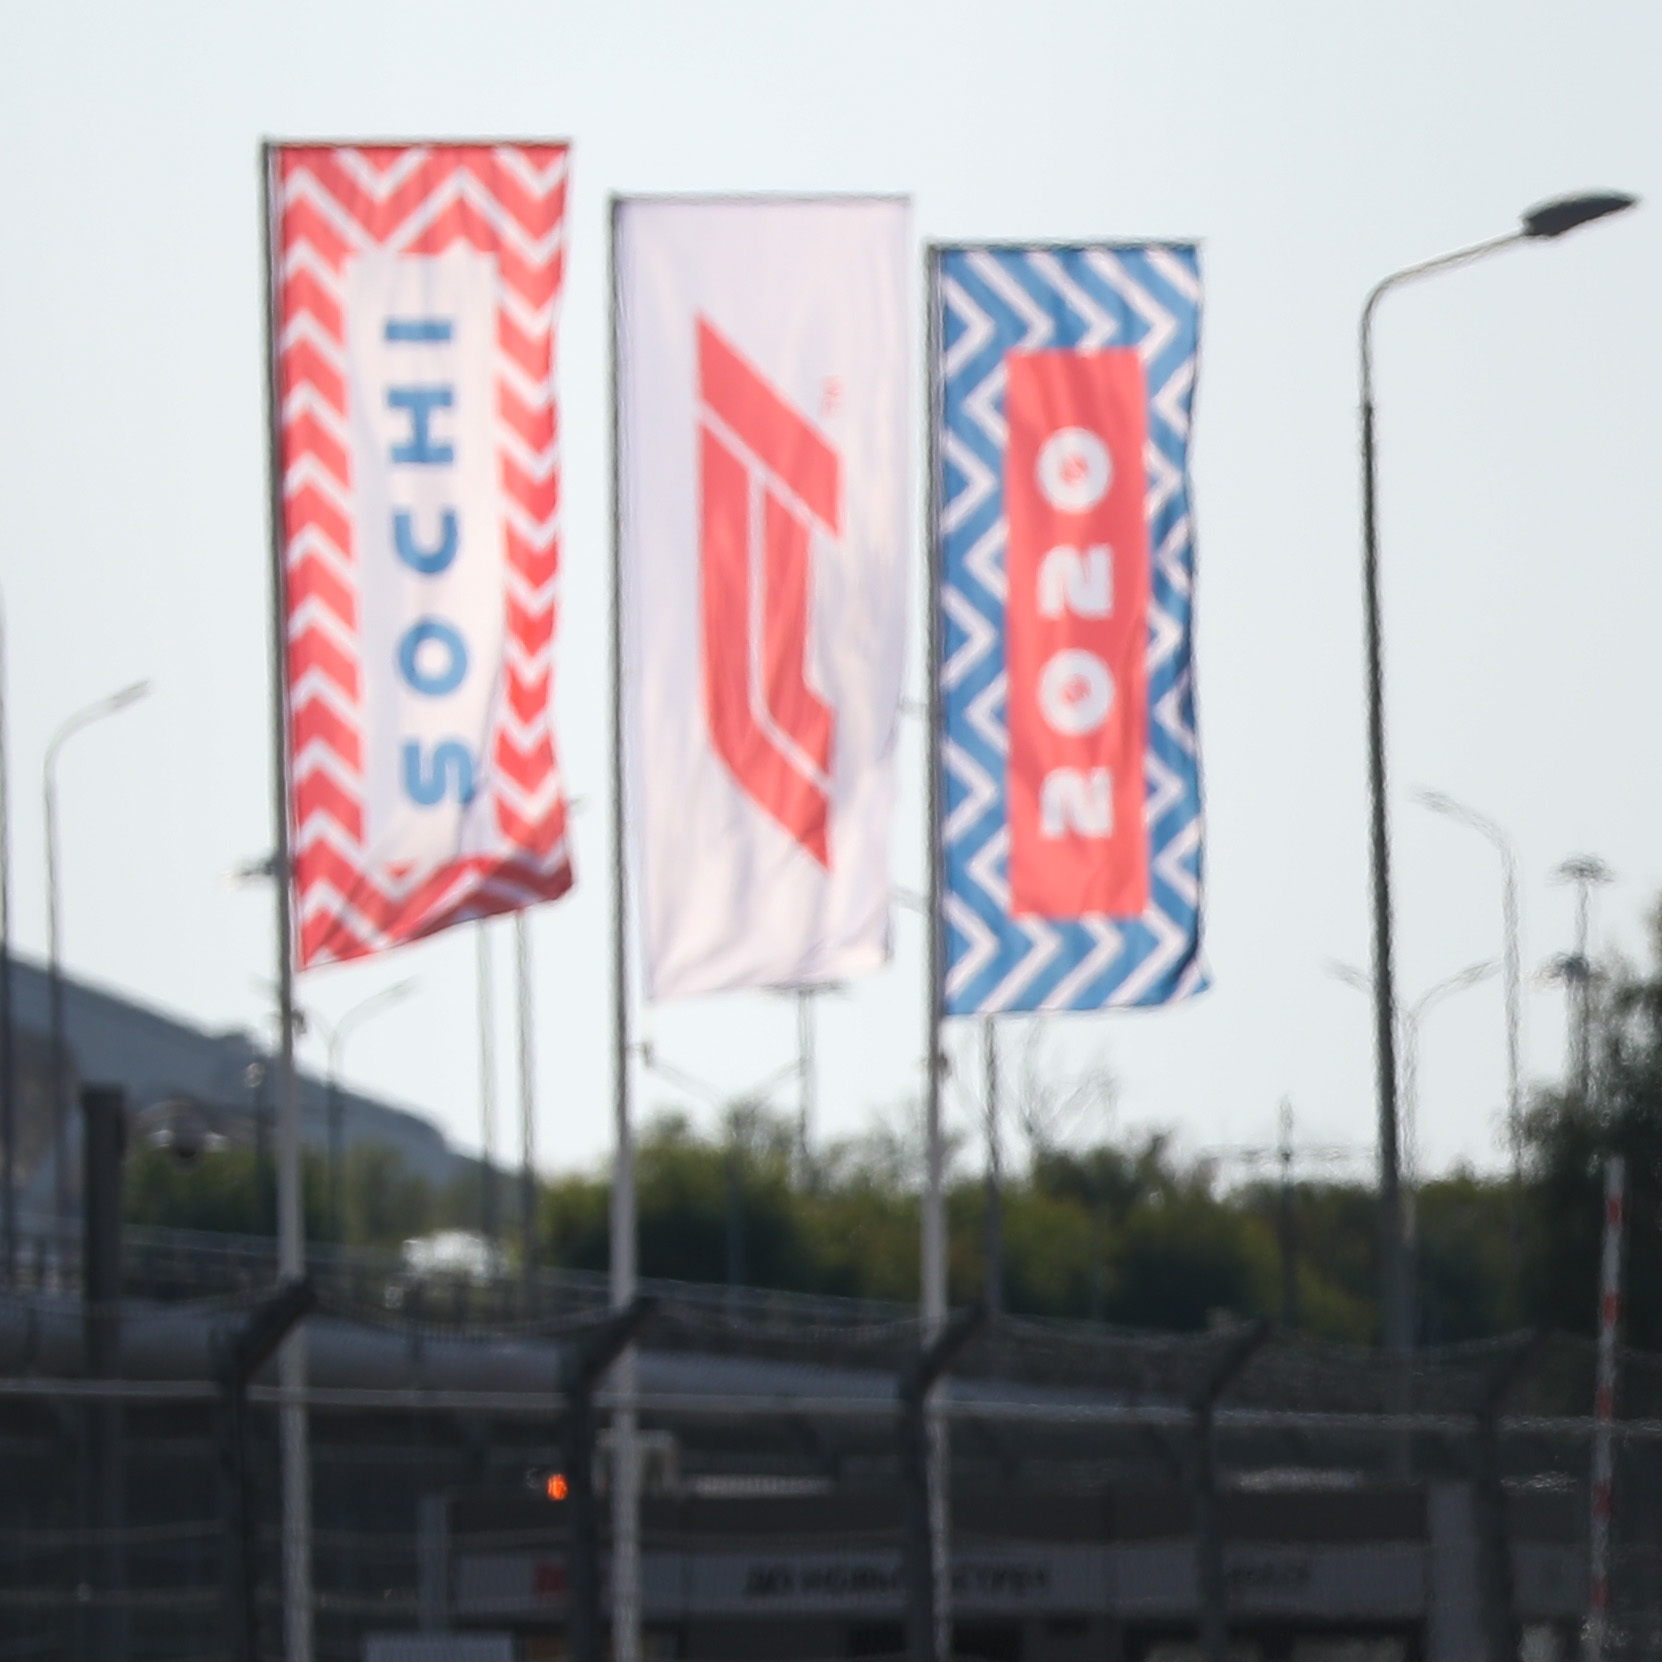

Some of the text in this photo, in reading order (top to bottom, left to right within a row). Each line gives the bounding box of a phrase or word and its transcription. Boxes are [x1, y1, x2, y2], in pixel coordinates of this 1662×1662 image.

[382, 315, 476, 806] SOCHI
[695, 306, 845, 875] F1
[1035, 425, 1116, 842] 2020
